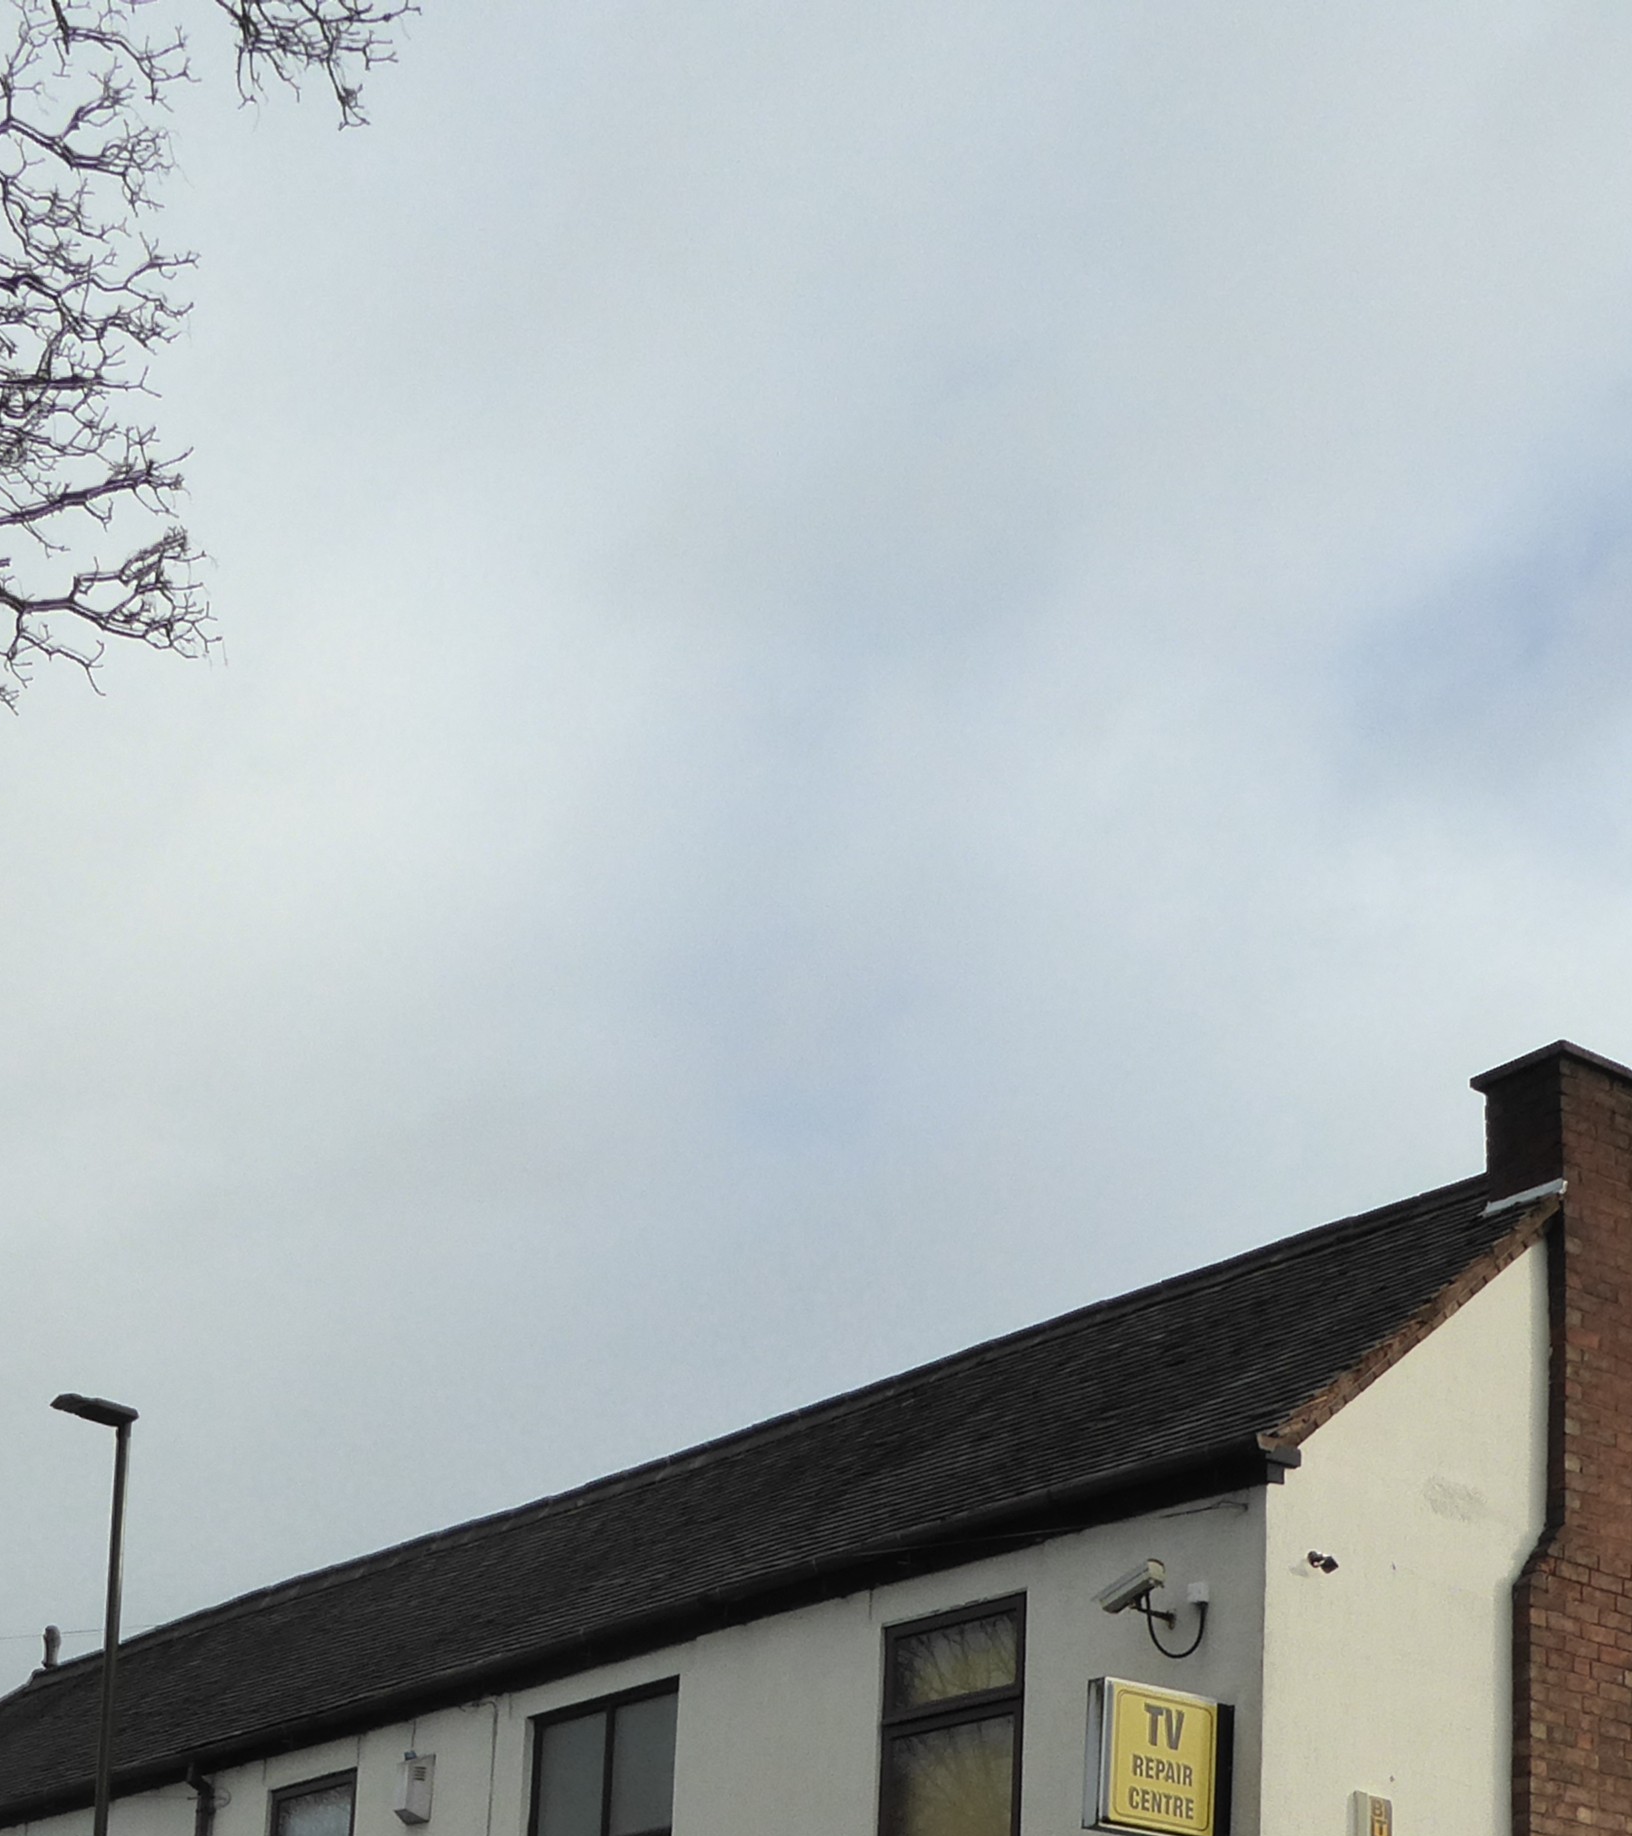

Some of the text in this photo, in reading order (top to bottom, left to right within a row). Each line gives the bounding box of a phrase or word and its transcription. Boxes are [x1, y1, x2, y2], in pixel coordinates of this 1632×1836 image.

[1144, 1702, 1184, 1751] TV
[1132, 1754, 1193, 1787] REPAIR
[1128, 1785, 1194, 1820] CENTRE
